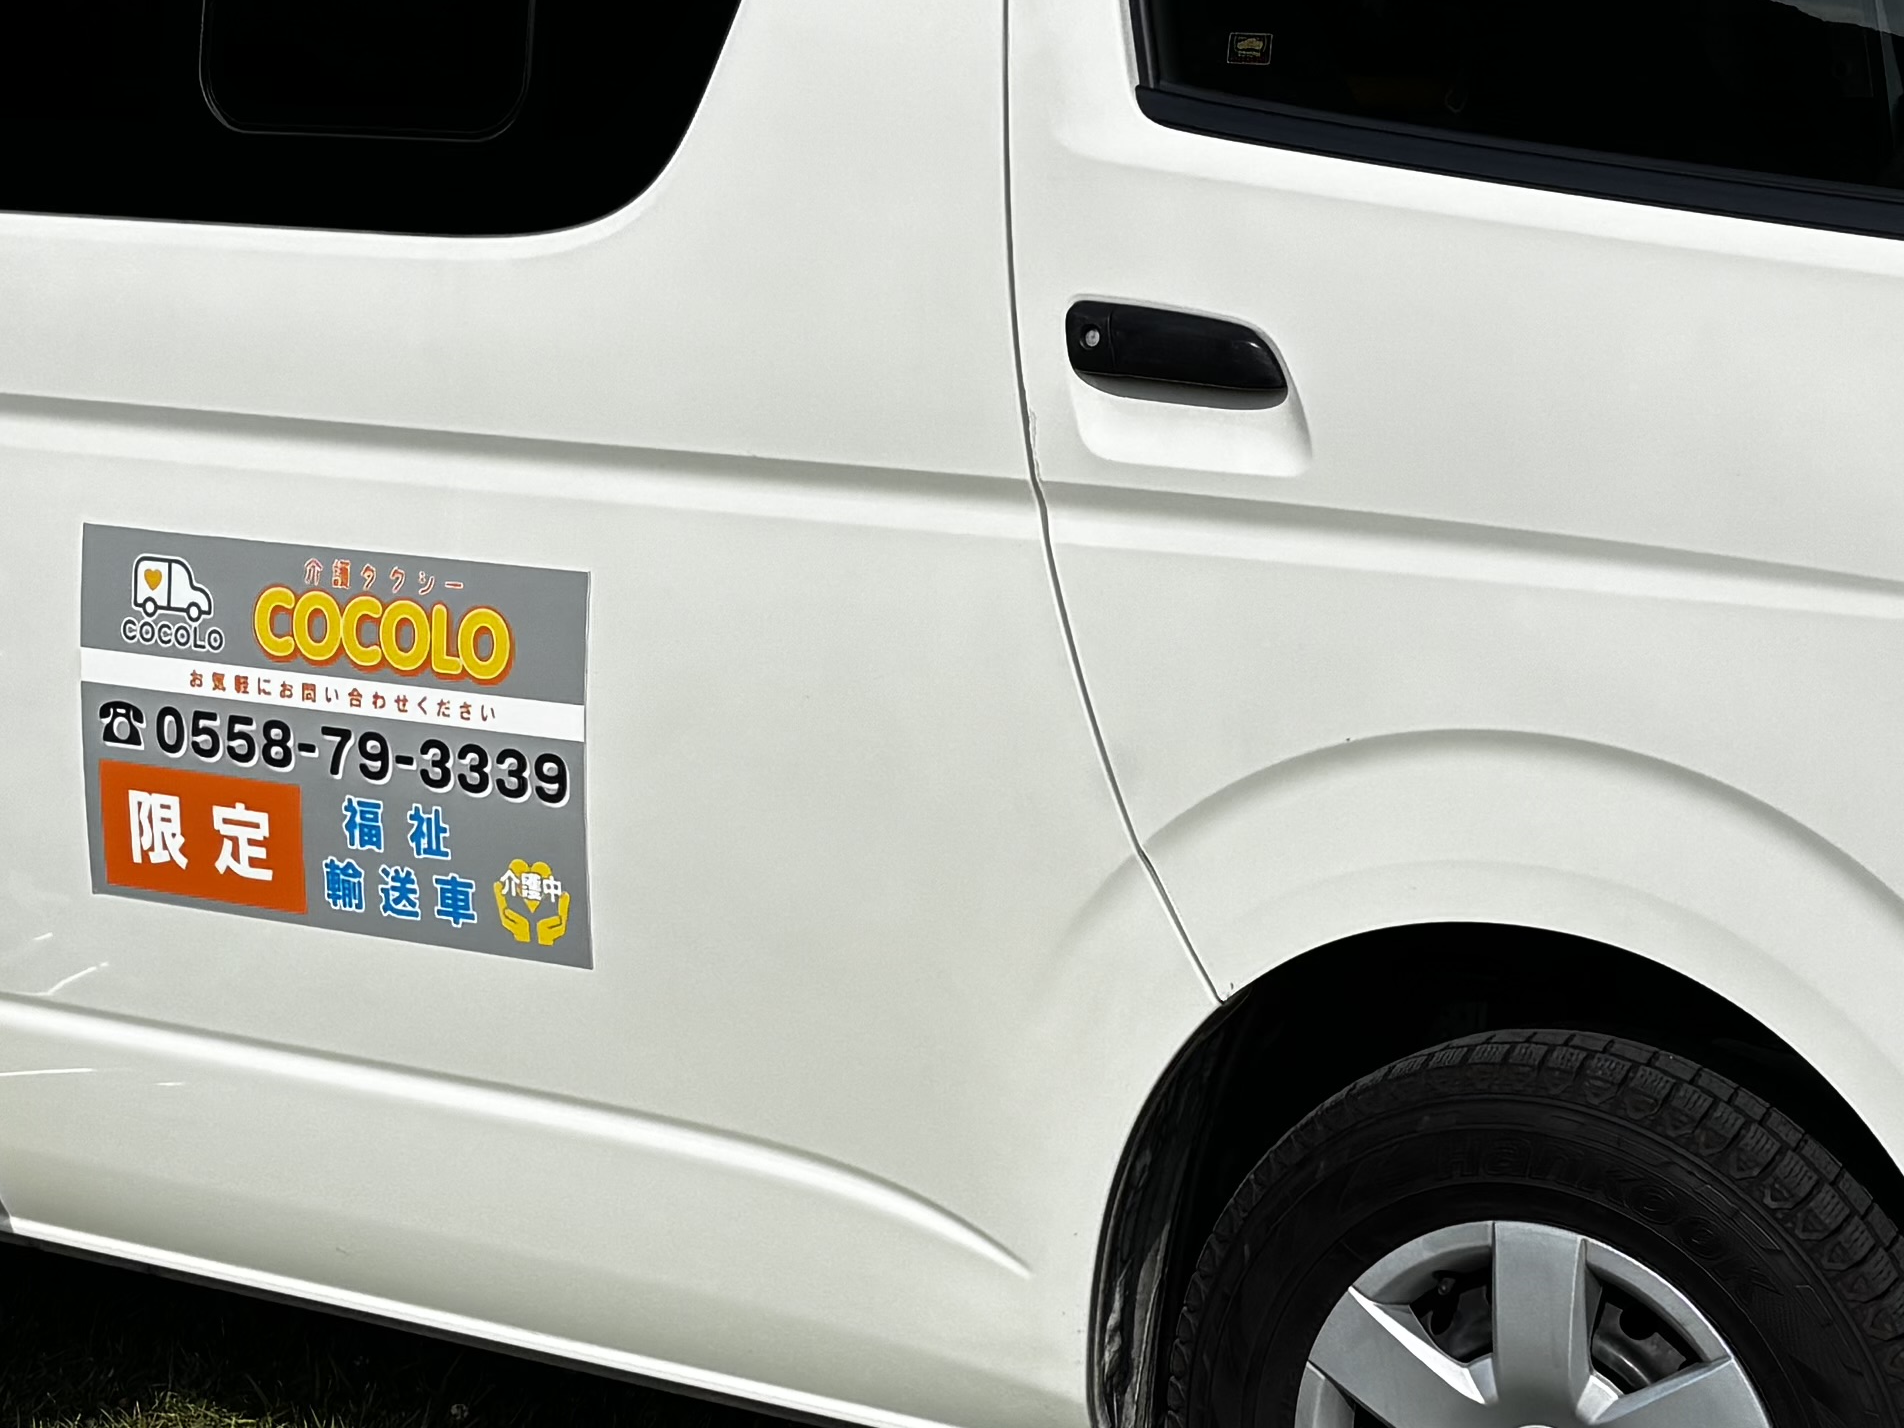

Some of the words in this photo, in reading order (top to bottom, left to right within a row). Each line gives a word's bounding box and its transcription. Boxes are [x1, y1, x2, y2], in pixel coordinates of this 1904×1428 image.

[303, 557, 464, 596] 介護タクシー
[121, 617, 224, 653] COCOLO
[252, 584, 514, 685] COCOLO
[189, 669, 496, 722] お気軽にお問い合わせください
[156, 705, 570, 805] 0558-79-3339
[127, 788, 274, 882] 限定
[342, 795, 451, 860] 福祉
[323, 856, 477, 928] 輸送車
